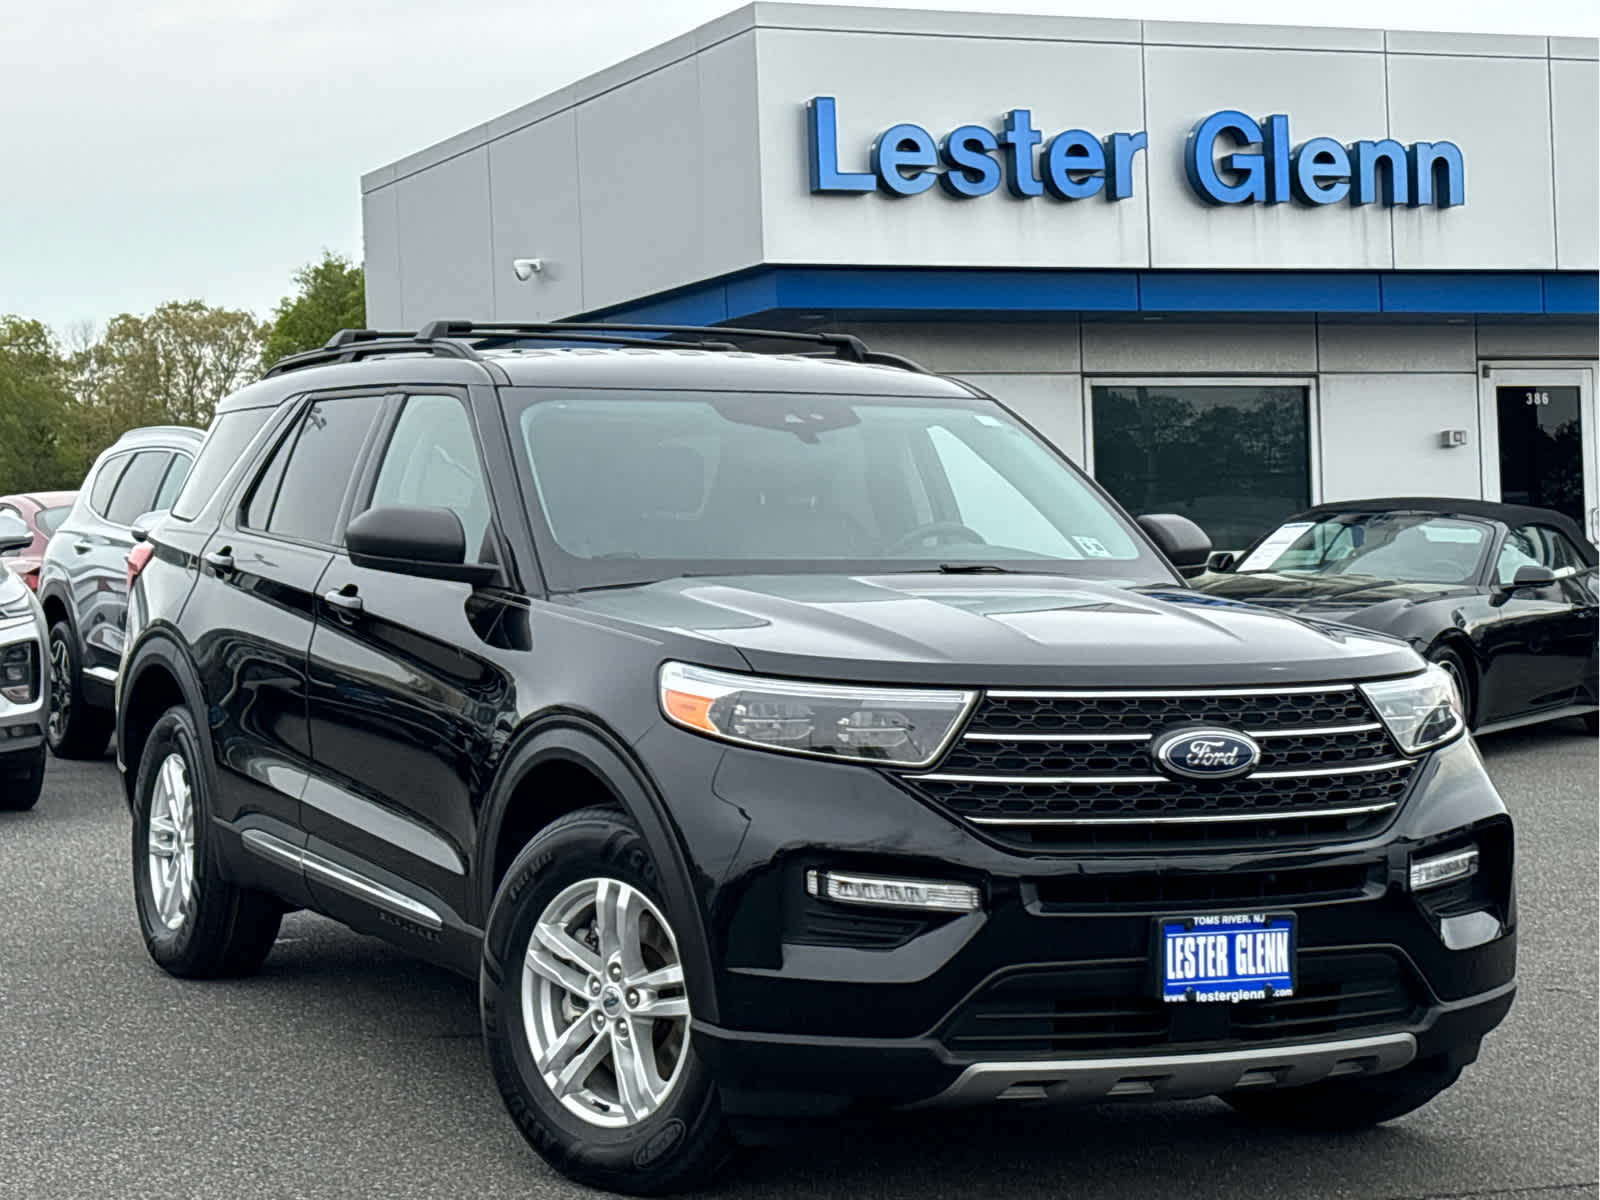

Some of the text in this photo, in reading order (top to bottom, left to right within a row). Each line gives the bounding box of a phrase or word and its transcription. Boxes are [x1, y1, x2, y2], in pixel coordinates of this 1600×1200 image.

[807, 96, 1466, 208] Lester Glenn
[1525, 392, 1549, 405] 386
[1186, 740, 1238, 765] Ford
[1193, 916, 1219, 926] TOMS
[1253, 913, 1266, 923] NJ
[1167, 931, 1288, 979] LESTER GLENN
